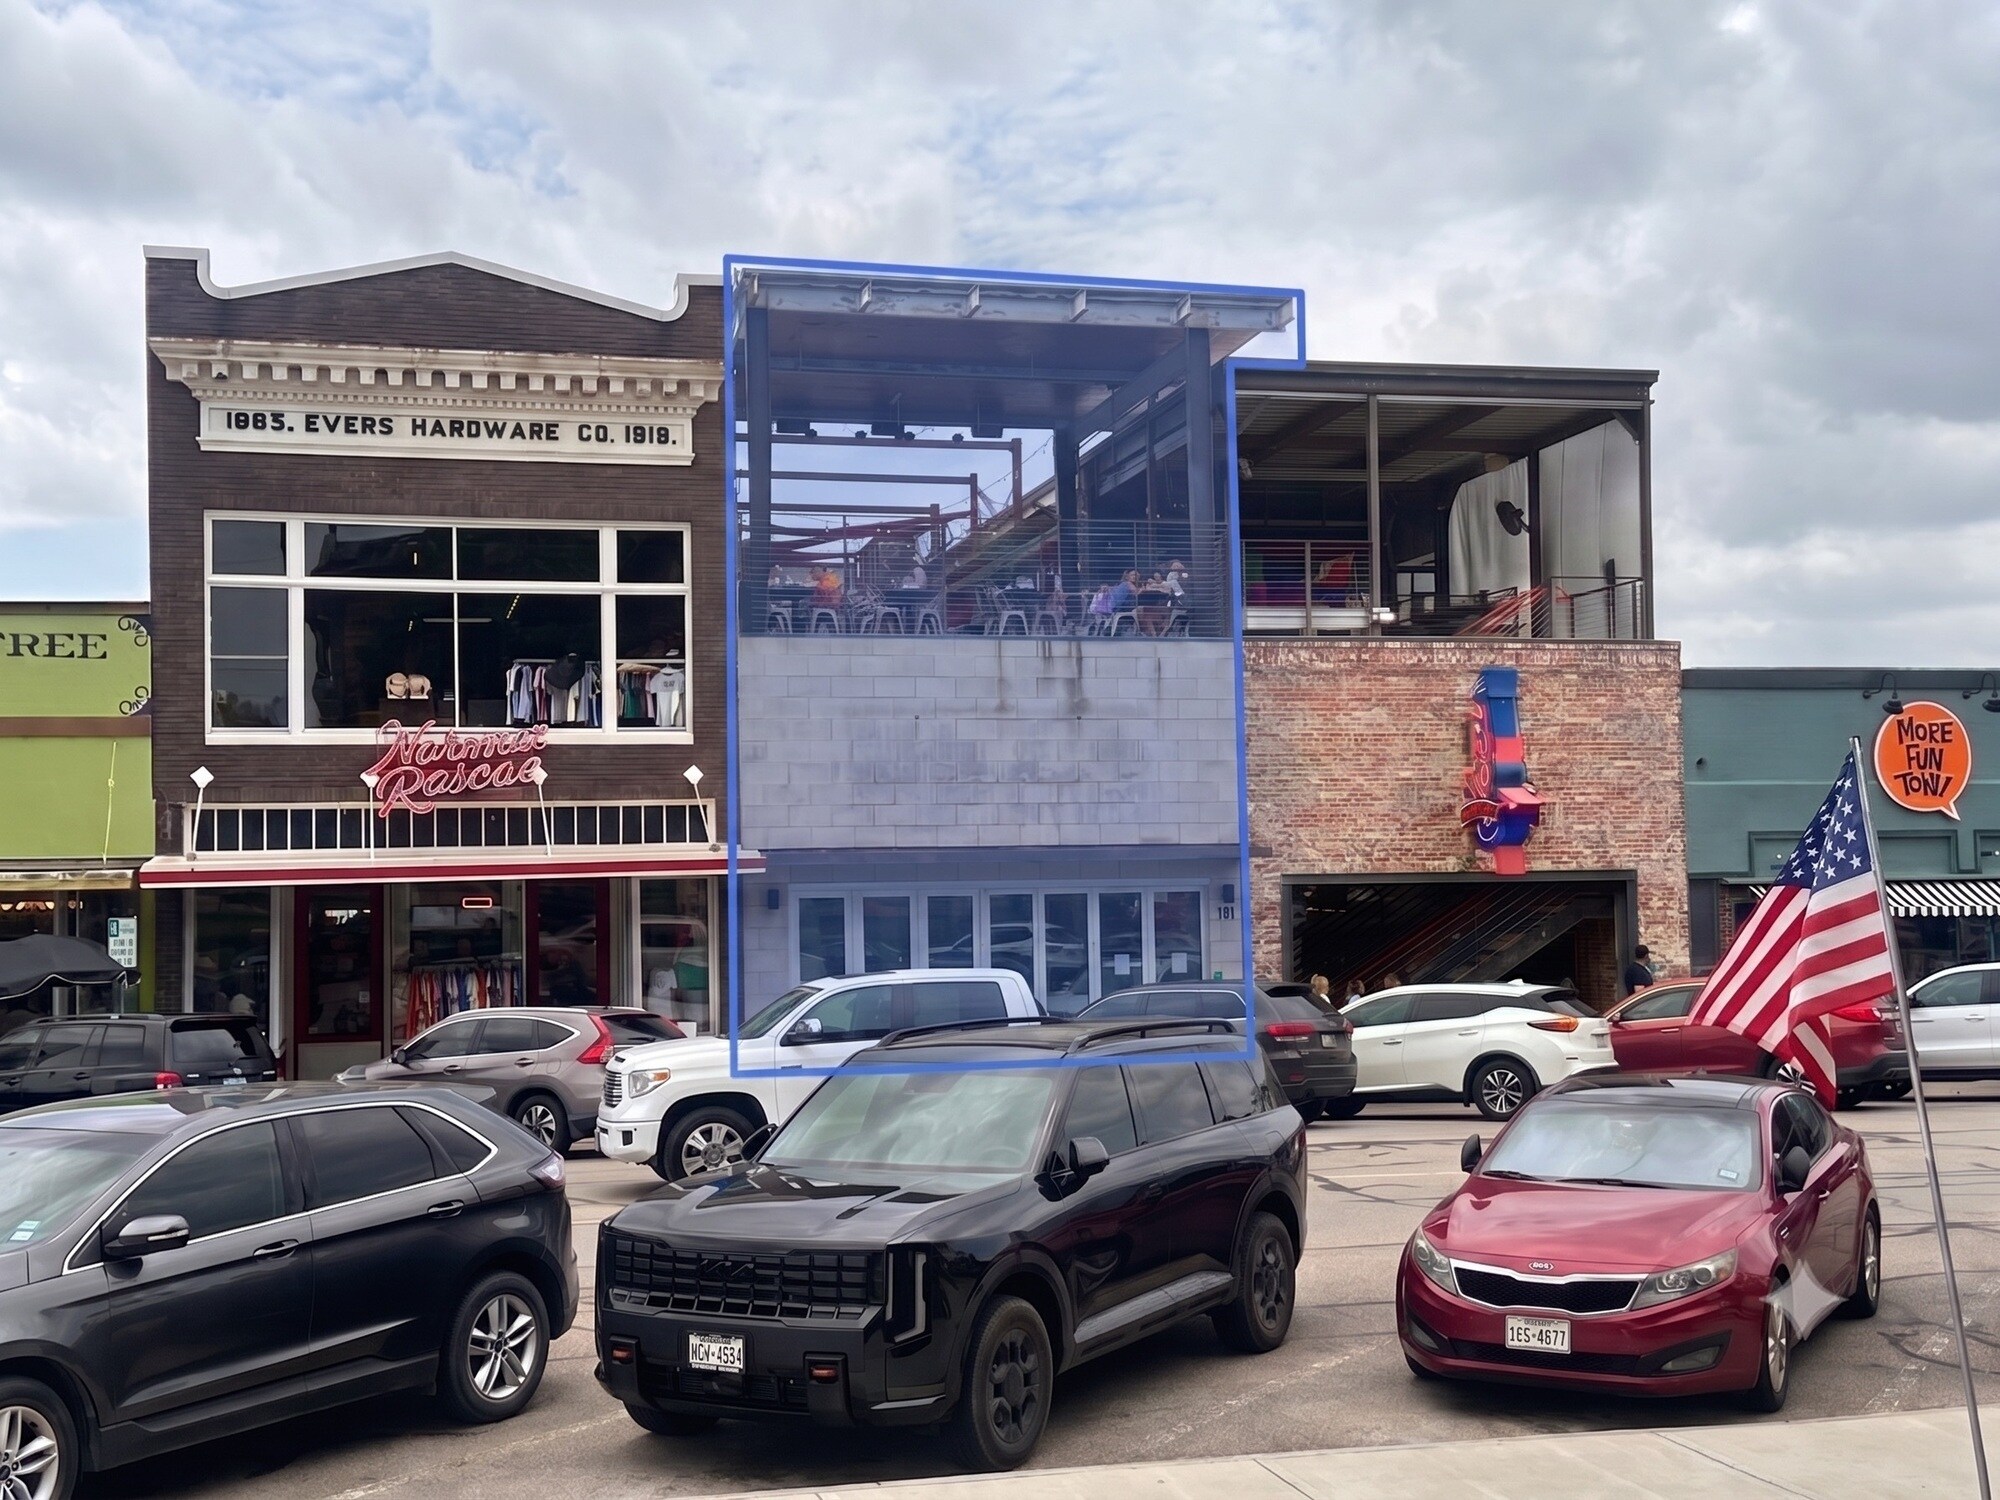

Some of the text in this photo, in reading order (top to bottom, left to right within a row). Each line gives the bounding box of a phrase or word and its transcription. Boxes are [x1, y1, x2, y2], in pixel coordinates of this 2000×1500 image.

[304, 413, 395, 436] EVERS
[411, 418, 560, 442] HARDWARE
[577, 423, 615, 444] CO.
[0, 632, 108, 660] REE
[1896, 716, 1954, 746] MORE
[1905, 743, 1945, 772] FUN
[1217, 906, 1235, 920] 181
